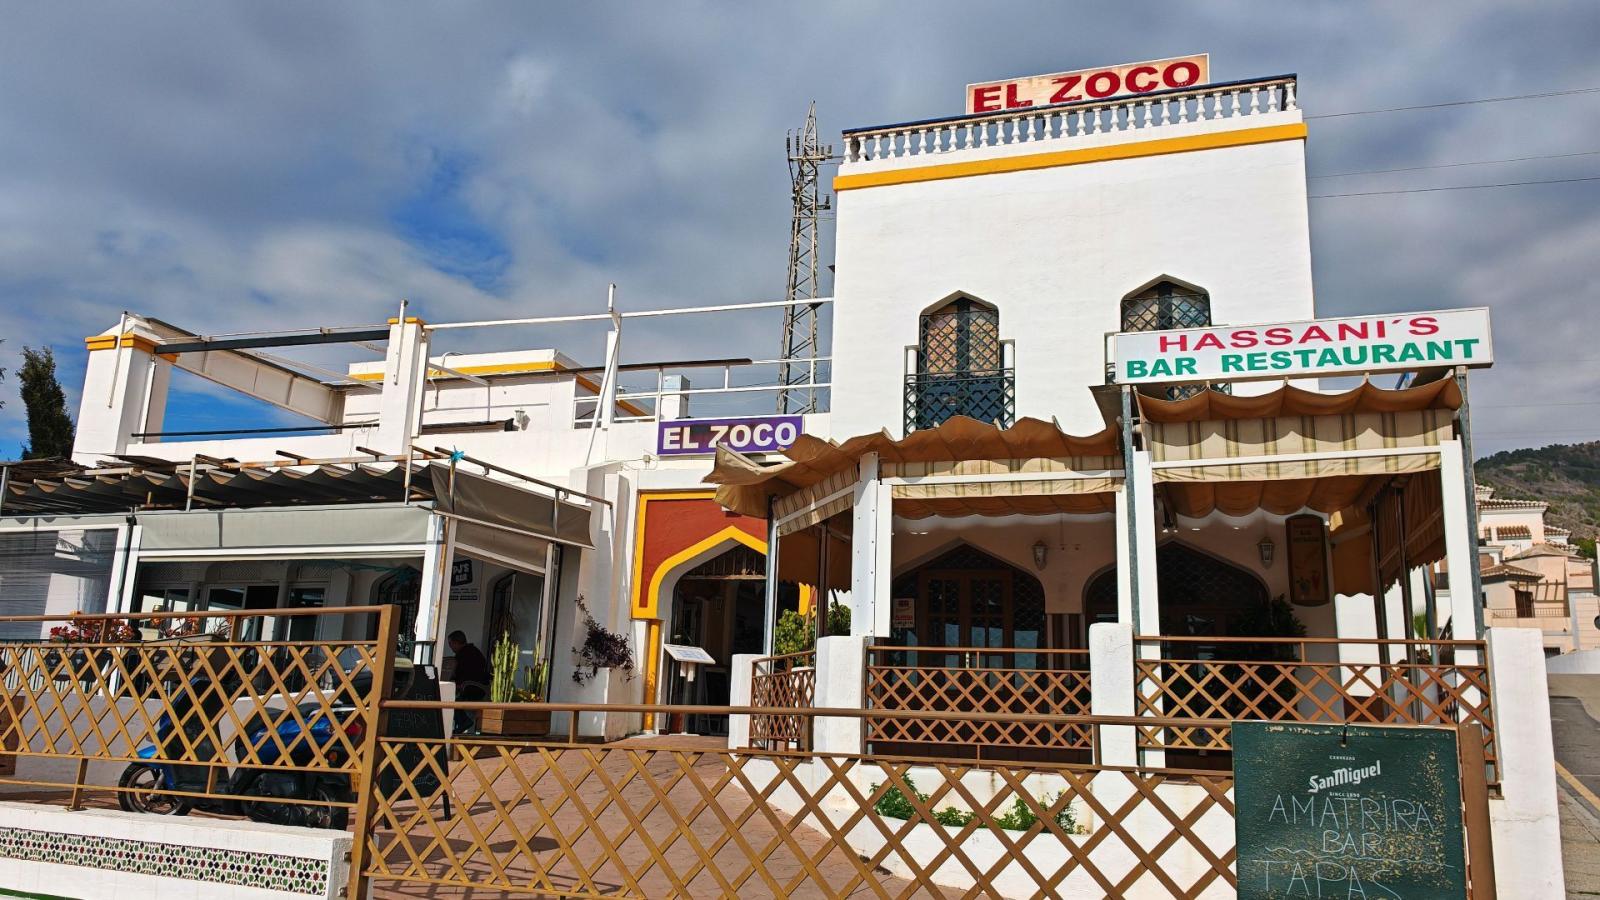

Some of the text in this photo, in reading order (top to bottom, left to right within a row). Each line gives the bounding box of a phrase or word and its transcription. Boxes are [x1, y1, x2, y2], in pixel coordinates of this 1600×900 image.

[973, 61, 1201, 113] EL ZOCO
[1126, 338, 1480, 378] BAR RESTAURANT
[662, 422, 797, 450] EL ZOCO
[1322, 829, 1383, 857] BAR
[1251, 859, 1402, 900] TAPAS
